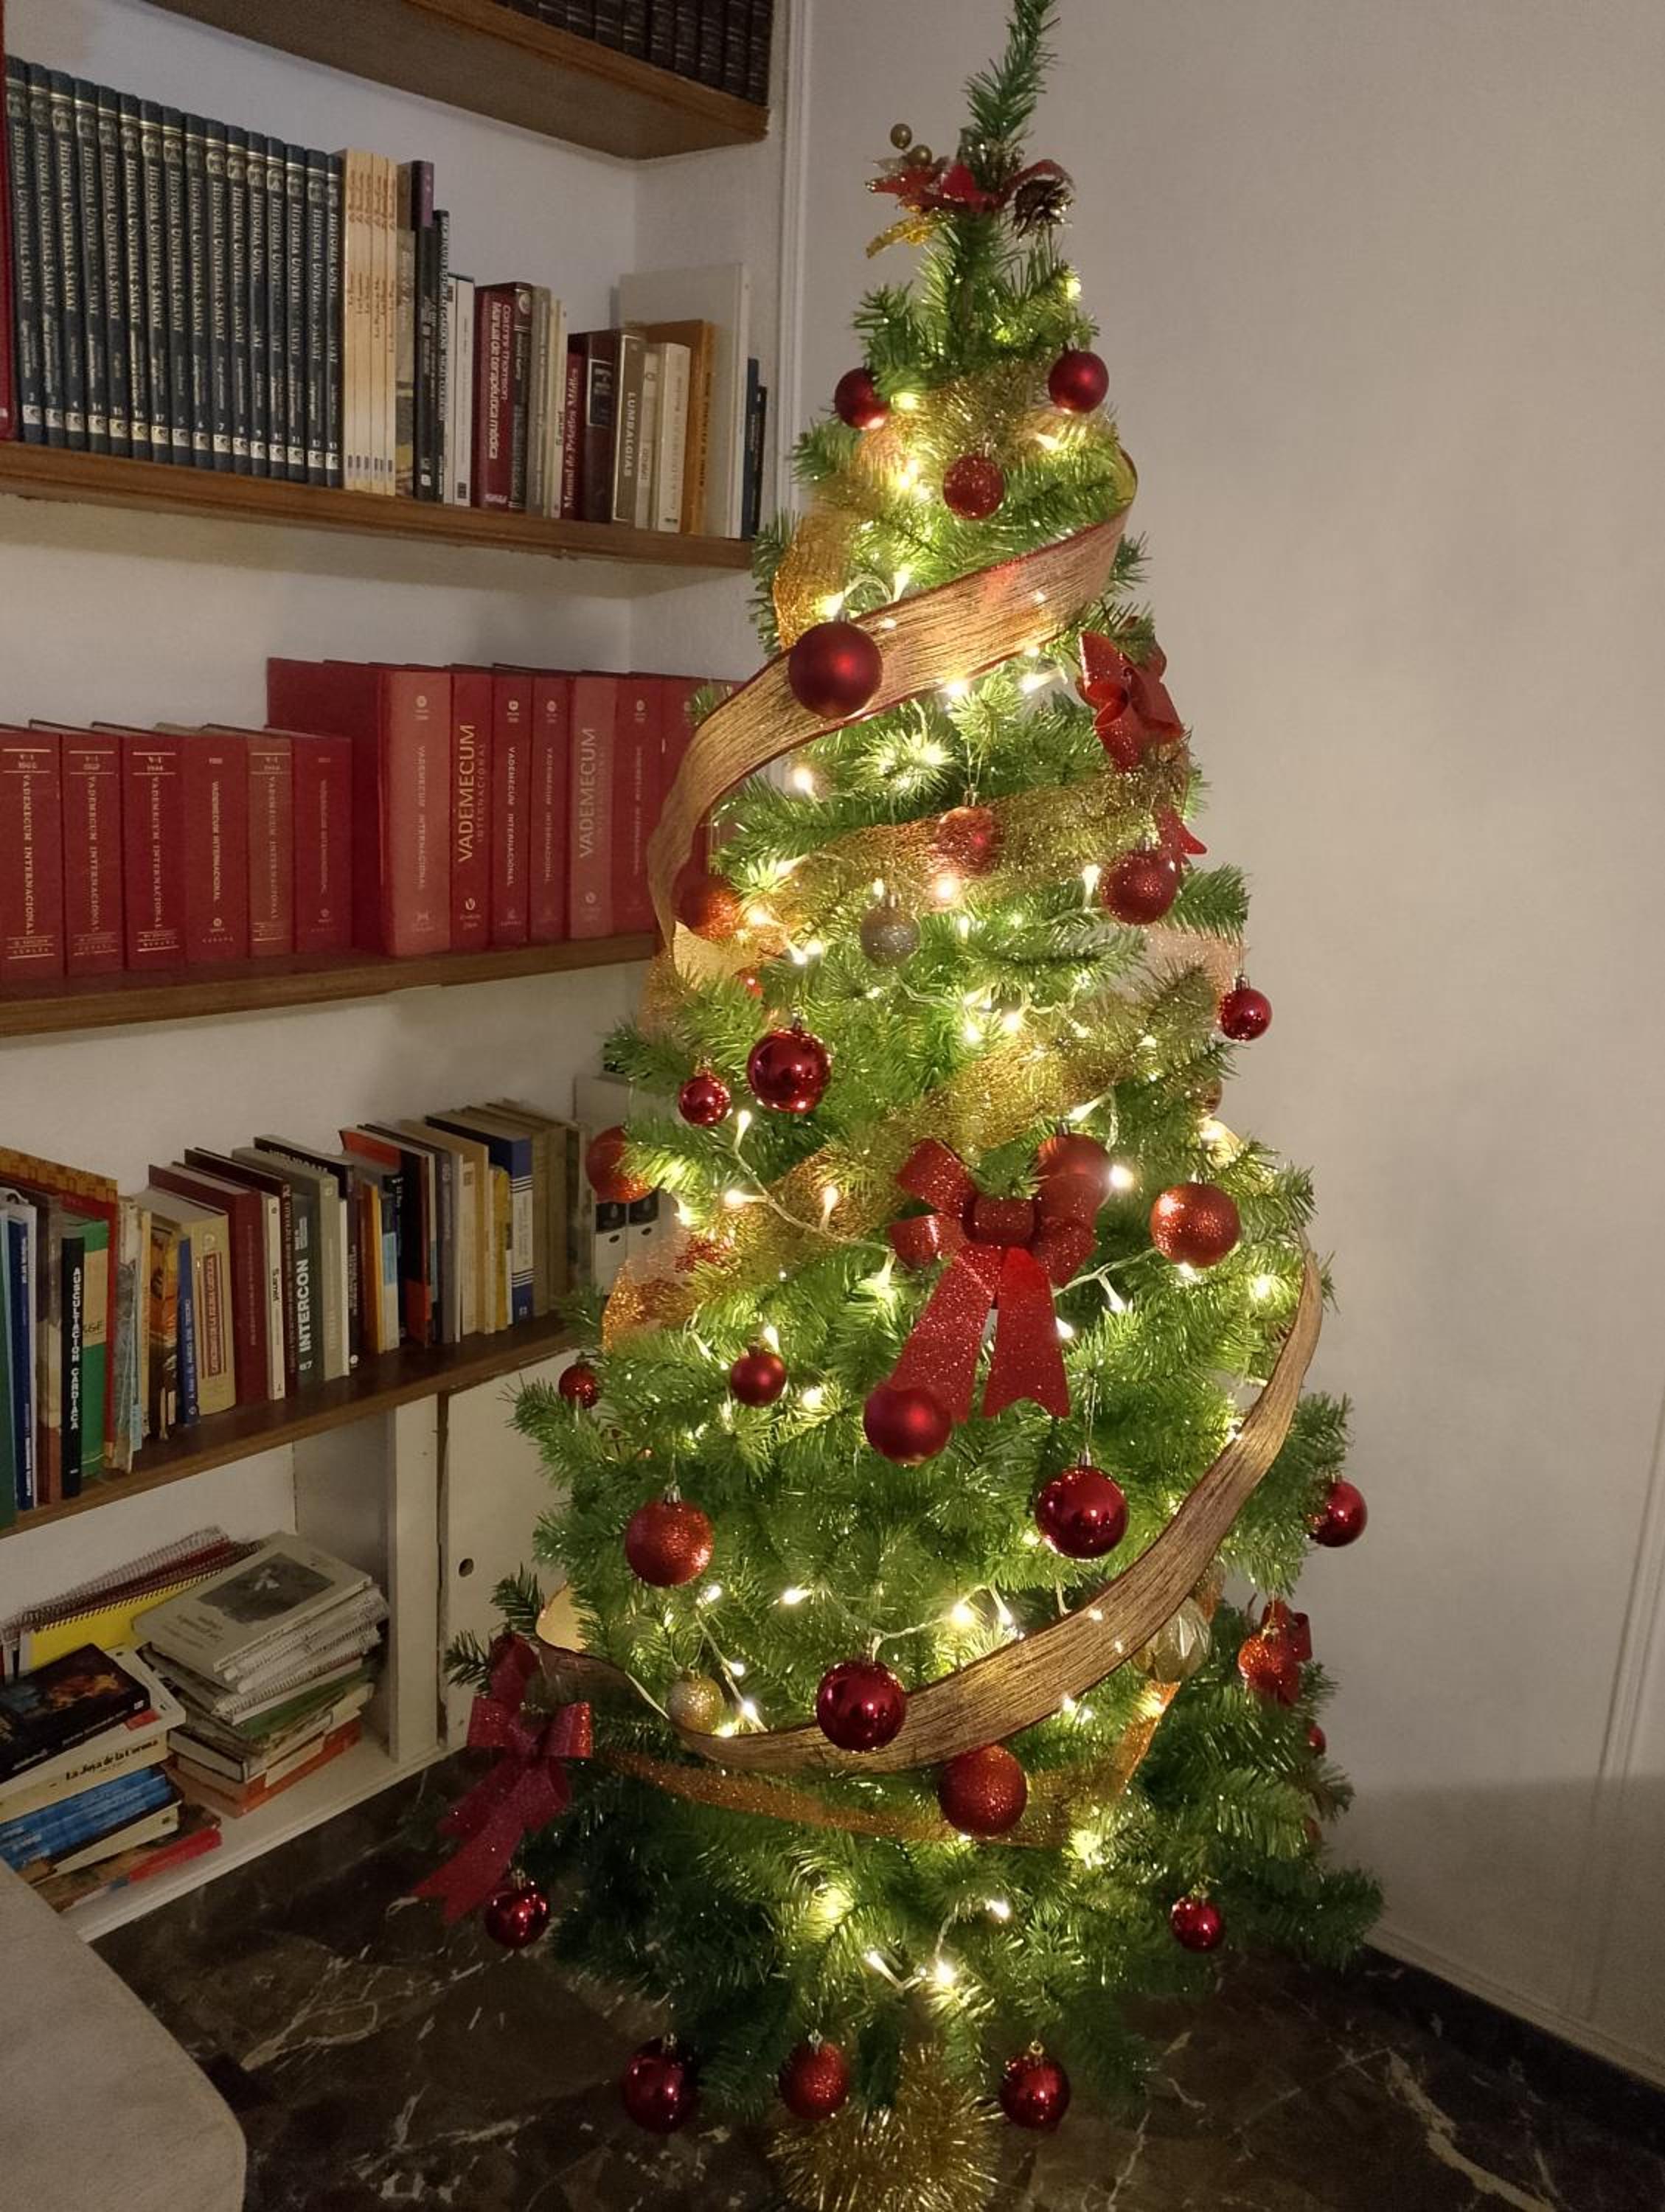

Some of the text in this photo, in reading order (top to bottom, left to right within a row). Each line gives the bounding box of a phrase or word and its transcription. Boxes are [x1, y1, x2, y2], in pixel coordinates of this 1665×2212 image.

[490, 341, 500, 355] de
[491, 302, 501, 340] Manual
[565, 454, 576, 467] de
[624, 392, 636, 477] LUMBALGIAS
[564, 470, 575, 508] Manual
[23, 775, 32, 841] VADEMECUM
[458, 724, 476, 862] VADEMECUM
[507, 747, 517, 887] VADEMECUM INTERNACIONAL
[579, 728, 596, 858] VADEMECUM
[24, 847, 34, 935] INTERNACIONAL
[296, 1259, 311, 1352] INTERCON
[70, 1368, 80, 1430] CARDIACA
[66, 1771, 78, 1781] La
[104, 1755, 114, 1766] de
[115, 1750, 125, 1761] la
